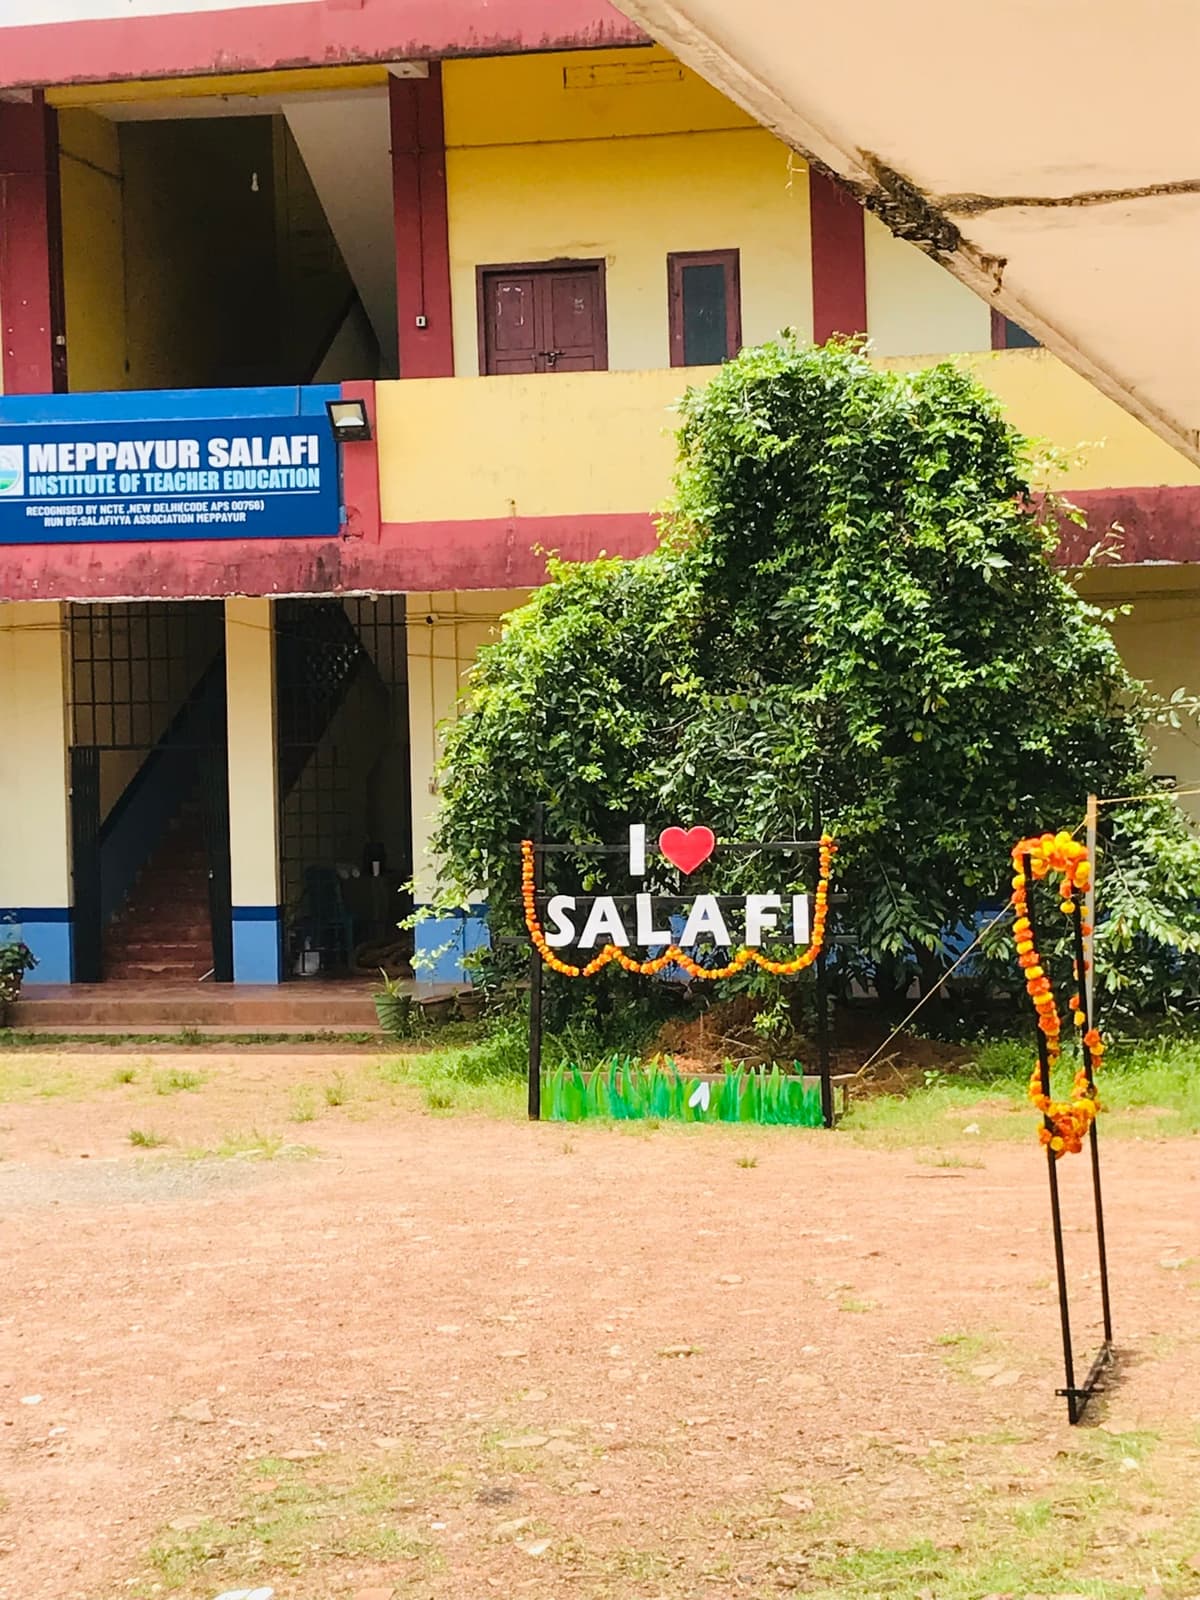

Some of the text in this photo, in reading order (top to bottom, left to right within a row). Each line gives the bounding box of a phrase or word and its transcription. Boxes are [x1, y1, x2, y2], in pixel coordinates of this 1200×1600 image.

[28, 435, 319, 472] MEPPAYUR SALAFI
[29, 467, 320, 496] INSTITUTE OF TEACHER EDUCATION
[26, 505, 83, 516] RECOGNISED
[85, 505, 97, 515] BY
[99, 504, 125, 514] NCTE
[210, 501, 229, 511] APS
[44, 517, 63, 527] RUN
[133, 513, 194, 525] ASSOCIATION
[196, 512, 246, 523] MEPPAYUR
[629, 824, 646, 876] I
[544, 893, 810, 948] SALAFI
